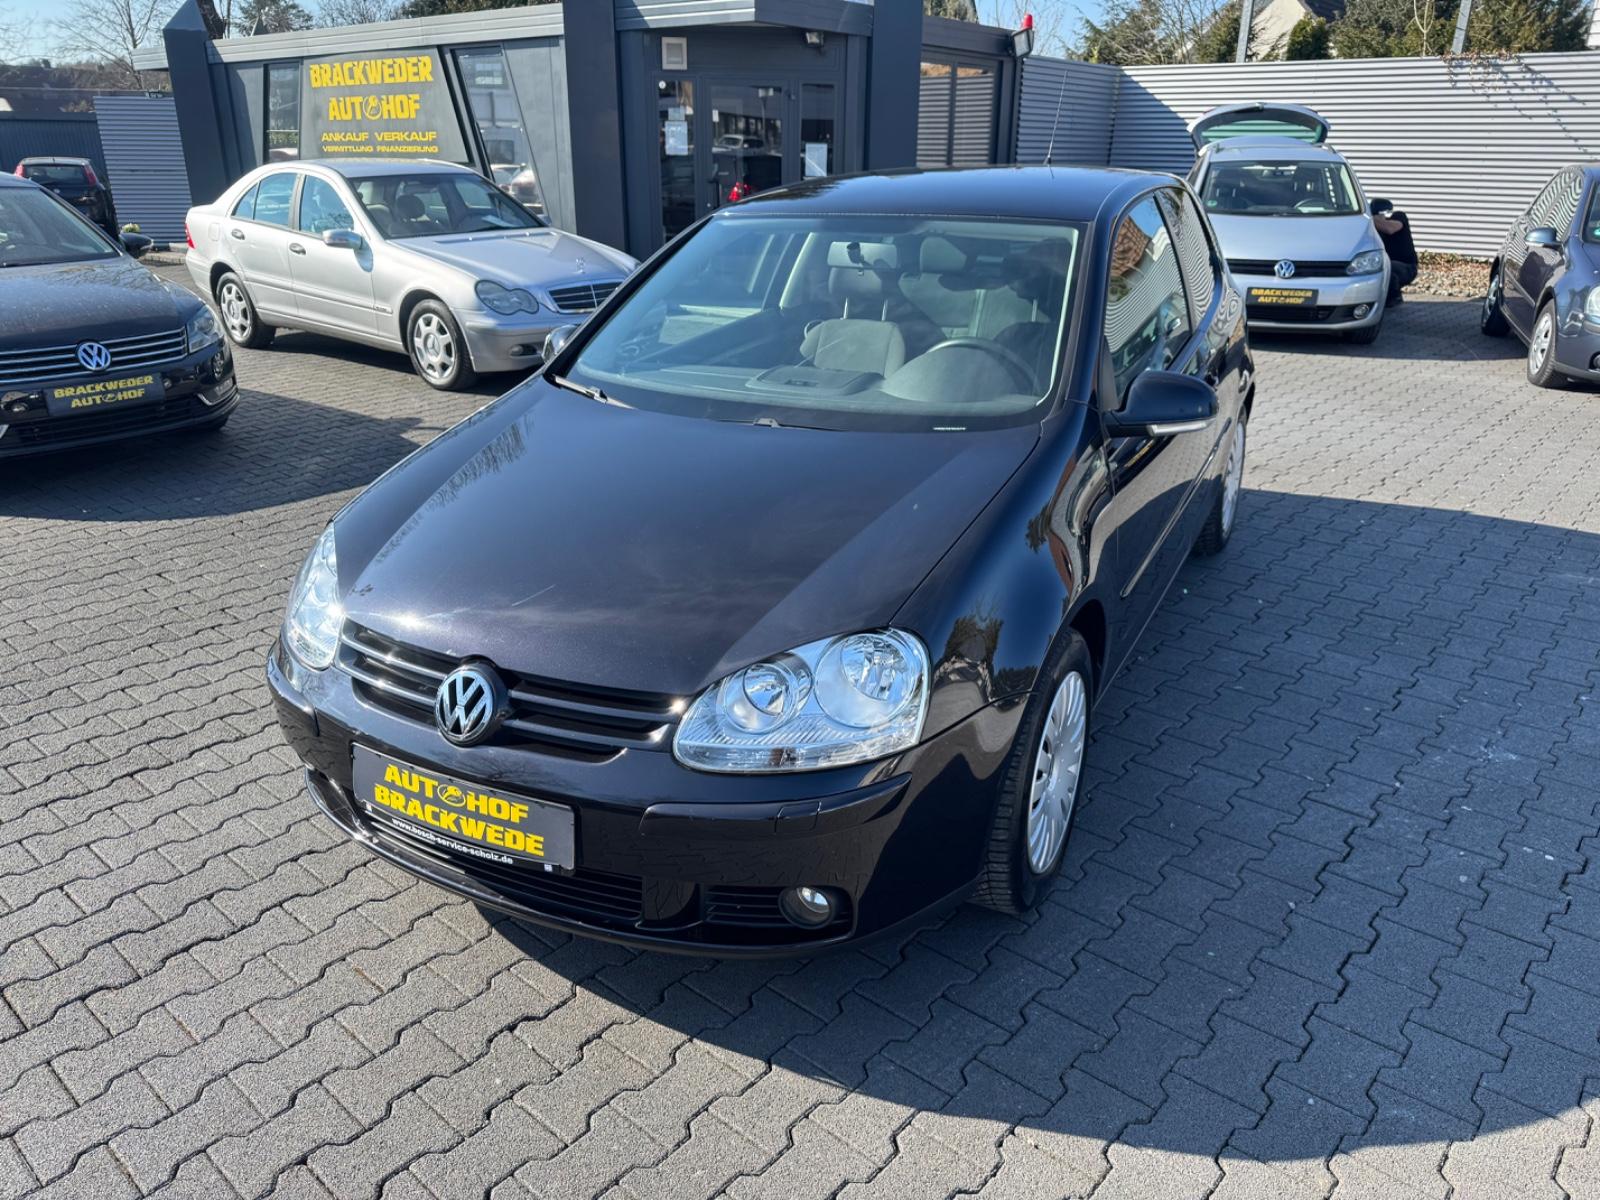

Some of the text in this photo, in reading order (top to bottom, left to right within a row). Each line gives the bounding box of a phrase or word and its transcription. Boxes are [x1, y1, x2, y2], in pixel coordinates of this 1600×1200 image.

[309, 55, 433, 88] BRACKWEDER
[321, 131, 437, 142] ANKAUF VERKAUF
[322, 145, 438, 153] VERMITTLUNG FINANZIERUNG
[53, 375, 154, 398] BRACKWEDER
[374, 783, 544, 857] BRACKWEDE
